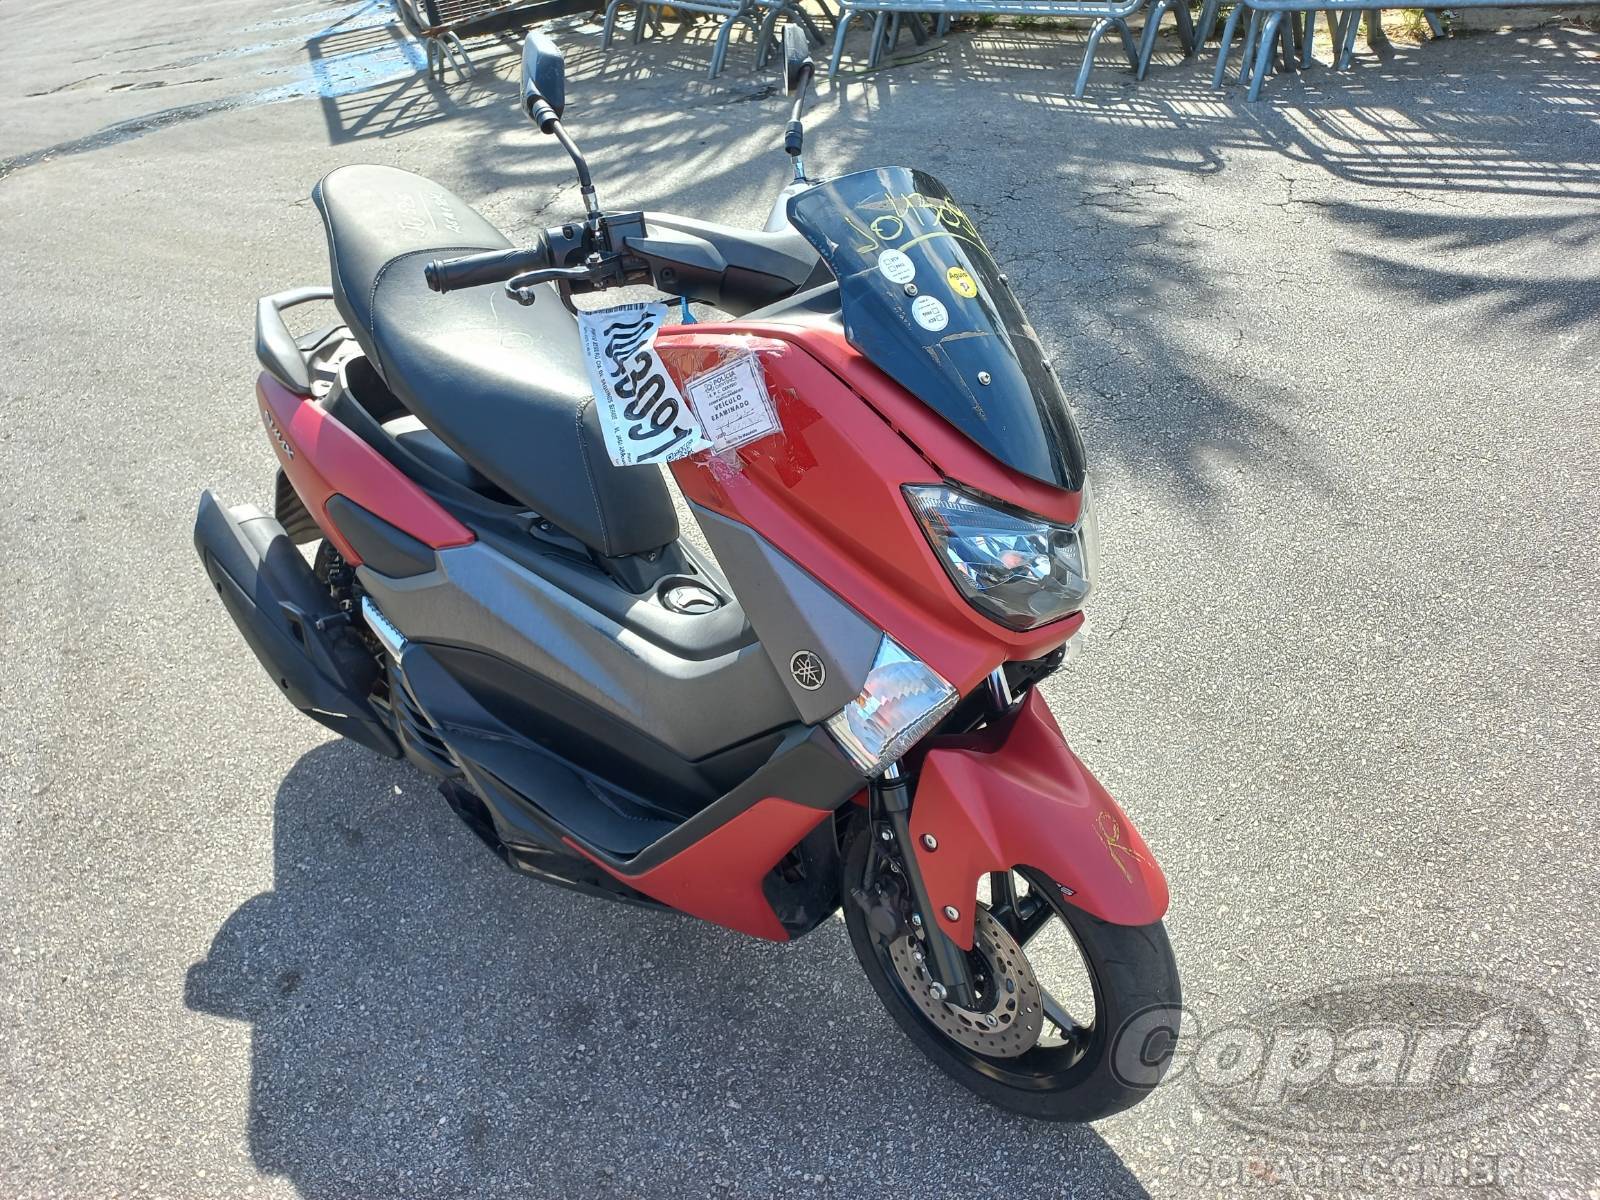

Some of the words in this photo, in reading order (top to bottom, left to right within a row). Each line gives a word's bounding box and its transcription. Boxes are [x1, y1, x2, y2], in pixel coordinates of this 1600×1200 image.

[604, 311, 693, 463] 1043091
[713, 370, 736, 386] POLÍCIA
[711, 400, 749, 421] EXAMINADO
[714, 394, 741, 411] VEÍCULO
